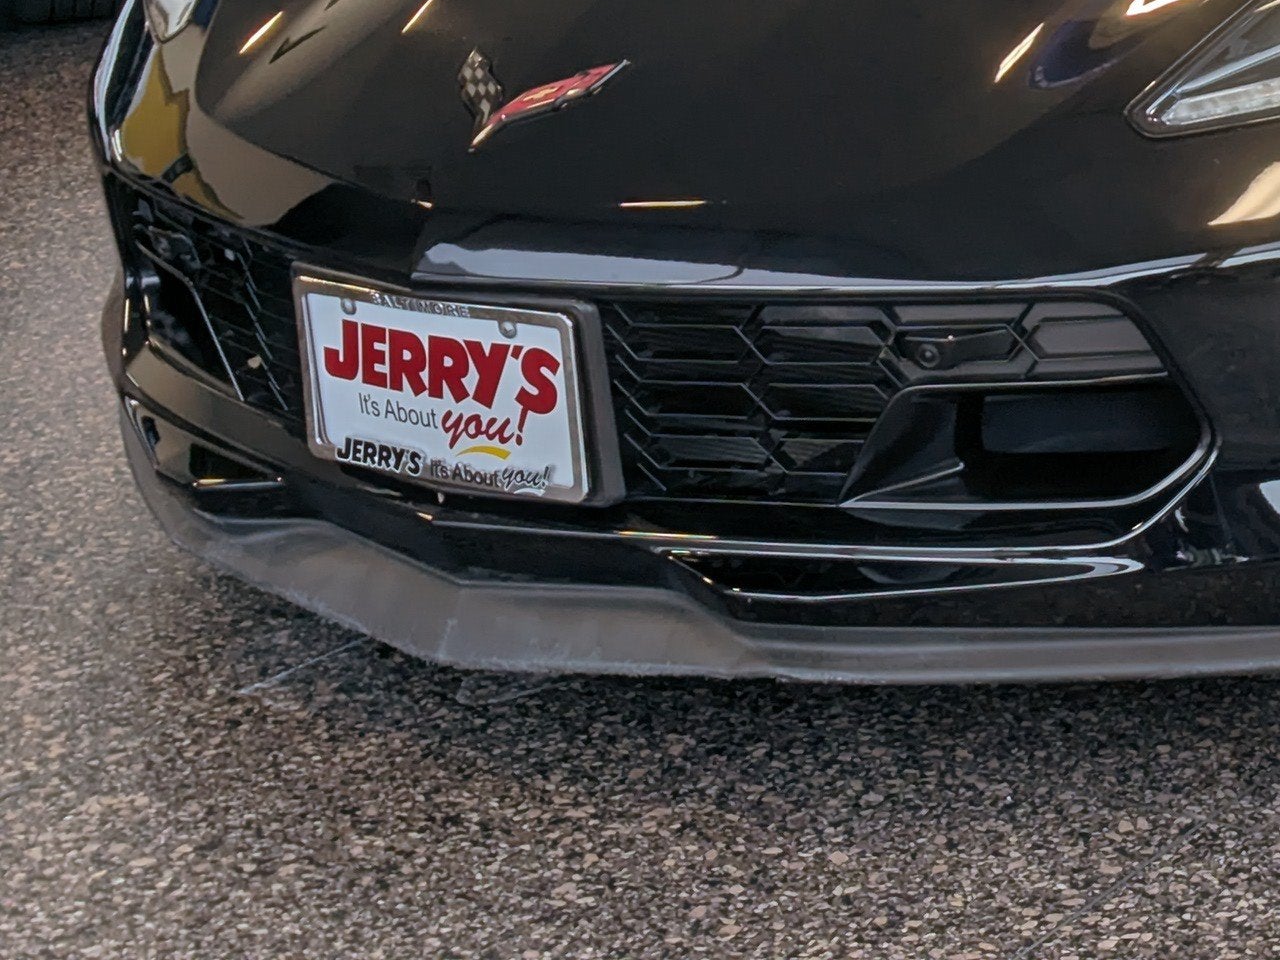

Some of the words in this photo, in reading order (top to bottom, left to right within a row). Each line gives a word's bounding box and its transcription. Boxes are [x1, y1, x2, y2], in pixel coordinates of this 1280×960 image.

[371, 291, 470, 318] BALTIMORE
[323, 319, 561, 415] JERRY'S
[358, 392, 380, 417] It's
[384, 399, 438, 429] About
[441, 406, 528, 449] you!
[336, 437, 422, 476] JERRY'S
[430, 459, 449, 479] It's
[452, 463, 501, 487] About
[502, 465, 552, 489] you!
